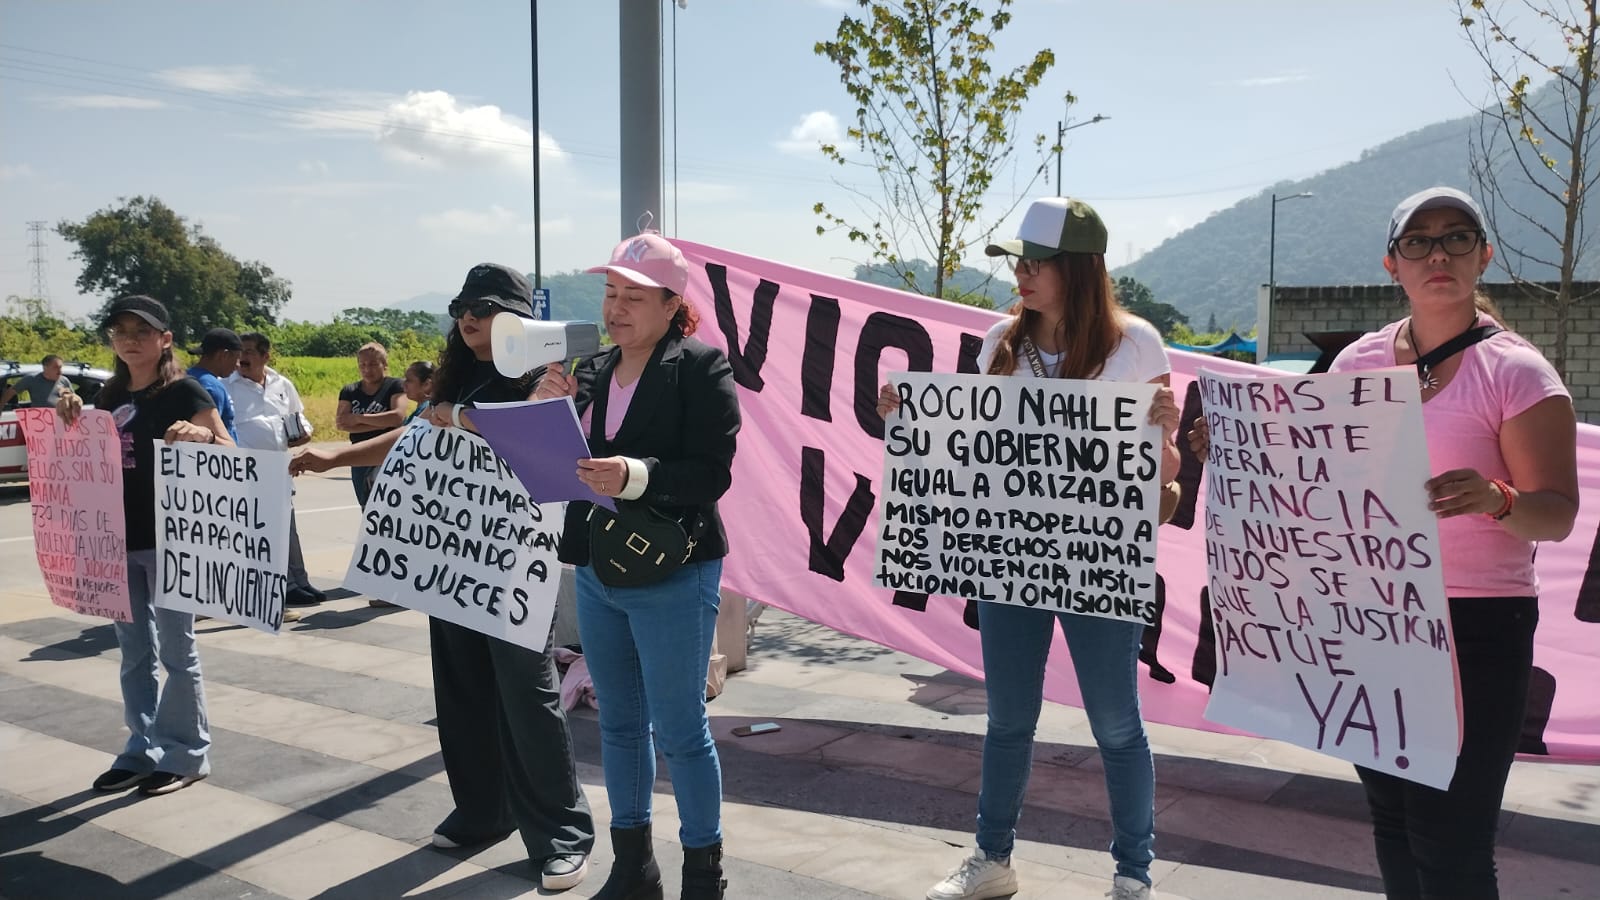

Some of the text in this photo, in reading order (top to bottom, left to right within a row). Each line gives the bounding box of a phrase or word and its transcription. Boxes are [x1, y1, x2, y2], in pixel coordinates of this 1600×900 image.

[898, 383, 1137, 431] ROCIO NAHLE
[1349, 377, 1406, 407] EL
[16, 409, 56, 434] 739
[27, 435, 47, 456] MIS
[55, 438, 91, 457] HIJOS
[99, 440, 107, 463] Y
[160, 447, 185, 478] EL
[197, 451, 258, 482] PODER
[395, 425, 514, 481] ESCUCHEN
[887, 426, 1156, 481] SU GOBIERNO ES
[1297, 455, 1330, 483] LA
[101, 461, 114, 484] SU
[383, 457, 543, 522] LAS VICTIMAS
[891, 468, 1144, 510] IGUAL A ORIZABA
[61, 509, 88, 532] DIAS
[97, 510, 114, 534] DE
[161, 485, 266, 529] JUDICIAL
[373, 483, 401, 508] NO
[412, 494, 472, 531] SOLO
[886, 502, 1152, 542] MISMO ATROPELLO A
[1209, 472, 1401, 530] INFANCIA
[165, 516, 271, 563] APAPACHA
[366, 511, 548, 583] SALUDANDO A
[882, 525, 1155, 567] LOS DERECHOS HUMA-
[1205, 506, 1432, 571] DE NUESTROS
[82, 557, 126, 584] JUDICIAL
[356, 544, 529, 626] LOS JUECES
[882, 548, 932, 569] NOS
[940, 553, 1070, 585] VIOLENCIA
[1206, 539, 1426, 612] HIJOS SE VA
[163, 549, 287, 631] DELINCUENTES
[1002, 581, 1014, 601] Y
[1020, 584, 1157, 624] OMISIONES
[1211, 575, 1449, 653] QUE LA JUSTICIA
